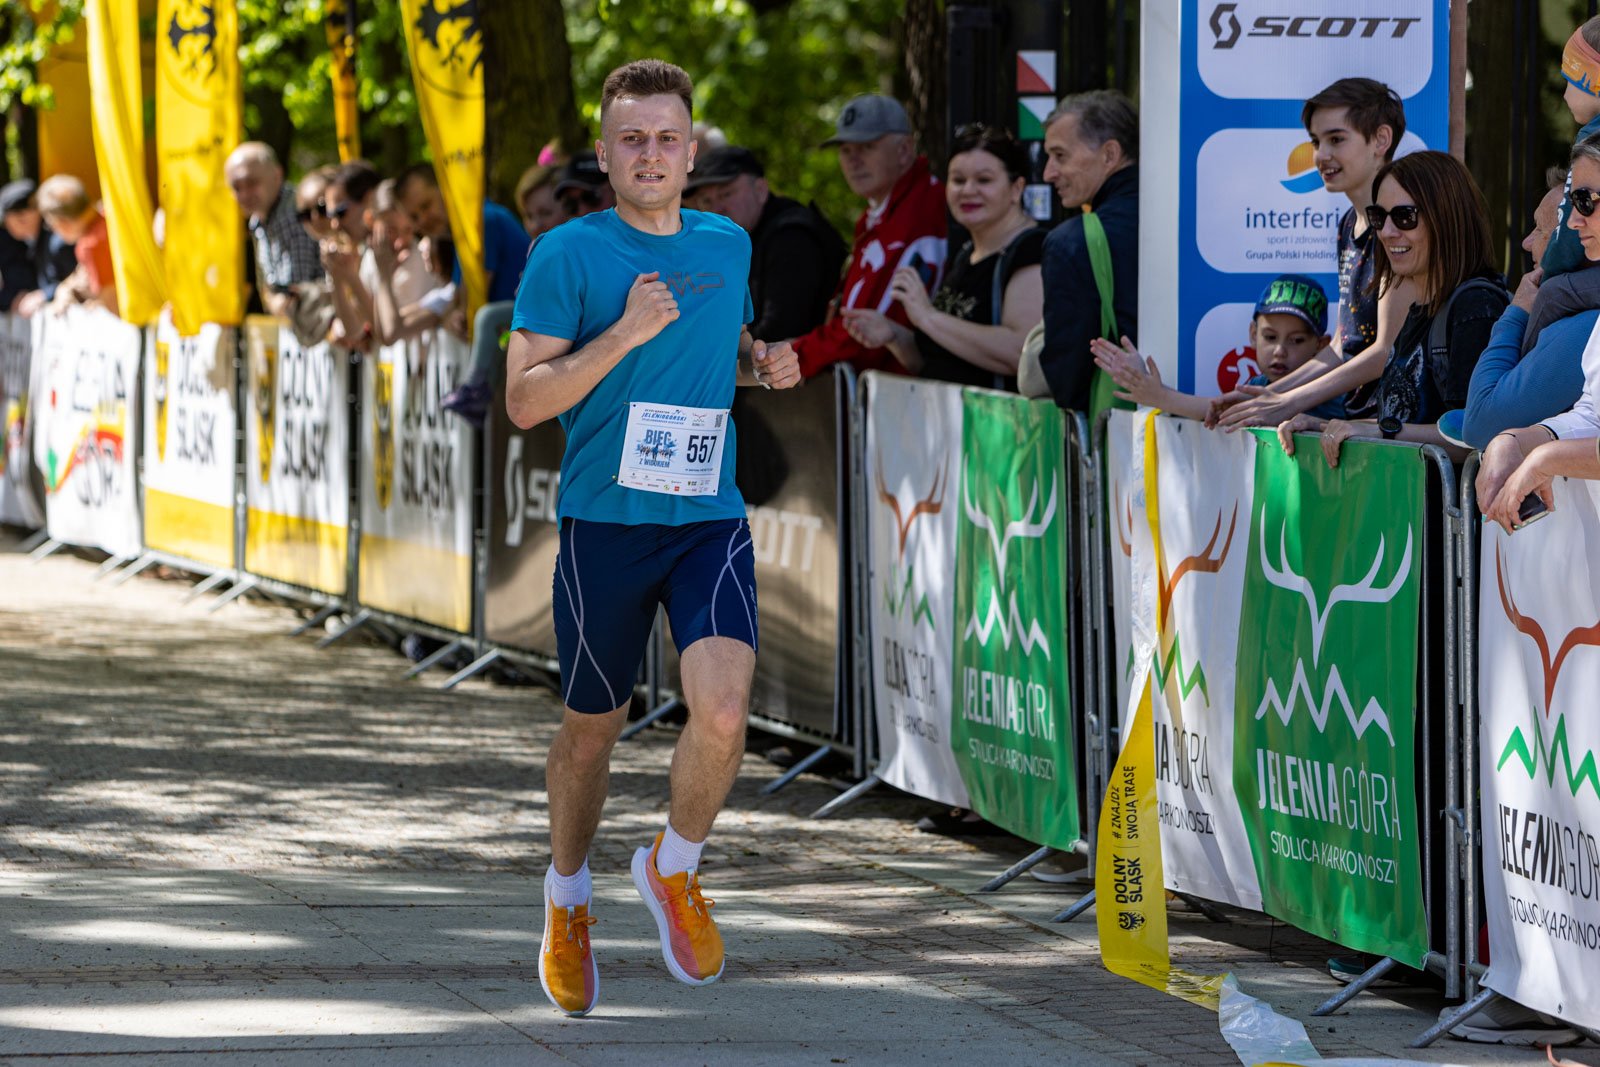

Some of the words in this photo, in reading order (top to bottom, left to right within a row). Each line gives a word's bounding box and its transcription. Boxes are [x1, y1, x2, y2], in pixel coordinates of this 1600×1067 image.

[1247, 17, 1421, 38] SCOTT
[1246, 207, 1339, 229] interferi
[1246, 250, 1273, 260] Grupa
[1275, 250, 1300, 259] Polski
[1303, 250, 1337, 260] Holding
[1267, 235, 1288, 245] sport
[1295, 235, 1328, 243] zdrowie
[686, 435, 717, 463] 557
[1123, 765, 1137, 798] TRASĘ
[1126, 799, 1139, 839] SWOJĄ
[1270, 830, 1321, 865] STOLICA
[1321, 842, 1398, 884] KARKONOSZY
[1564, 821, 1600, 902] GÓR
[1113, 853, 1128, 904] DOLNY
[1126, 857, 1143, 903] ŚLĄSK
